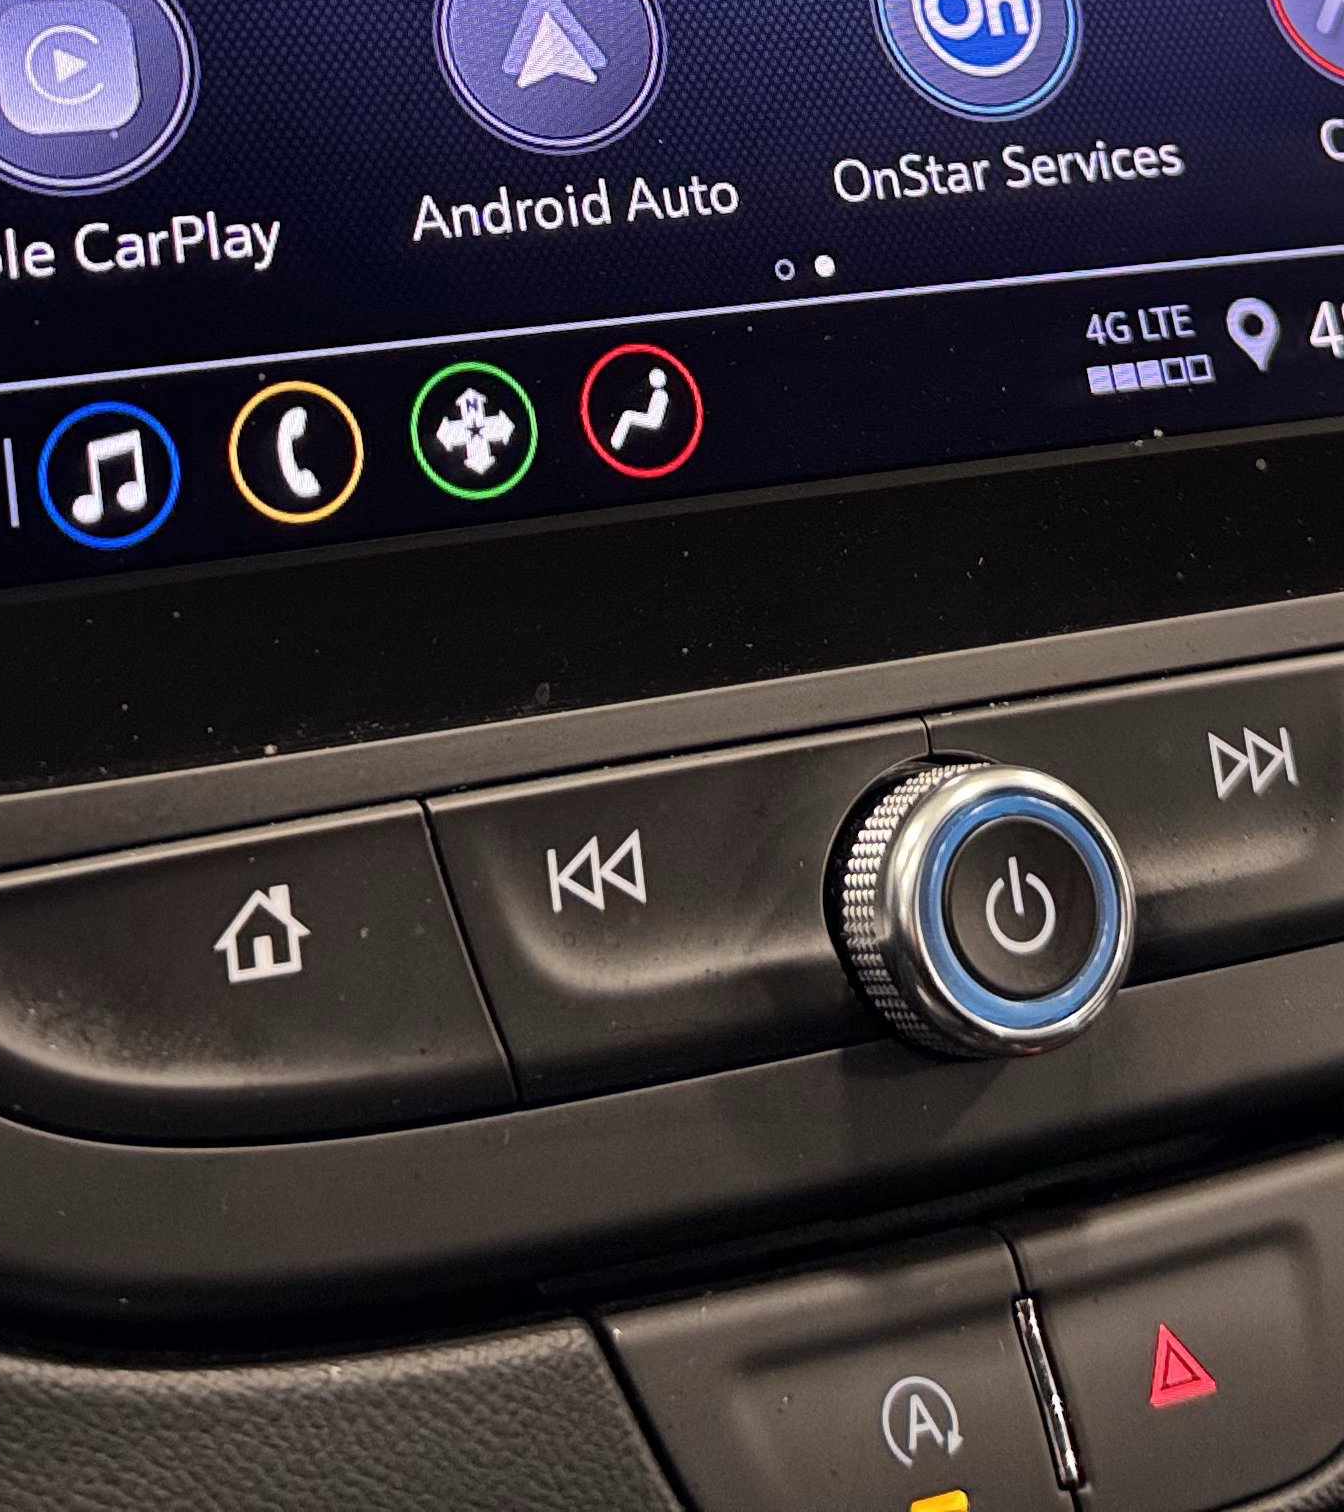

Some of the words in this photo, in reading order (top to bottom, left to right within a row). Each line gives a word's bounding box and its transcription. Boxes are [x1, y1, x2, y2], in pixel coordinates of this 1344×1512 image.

[832, 150, 990, 205] OnStar
[1005, 138, 1185, 190] Services
[412, 178, 614, 242] Android
[626, 174, 740, 219] Auto
[74, 210, 281, 275] CarPlay
[1085, 308, 1132, 347] 4G
[1137, 304, 1196, 342] LTE
[908, 1394, 944, 1450] A
